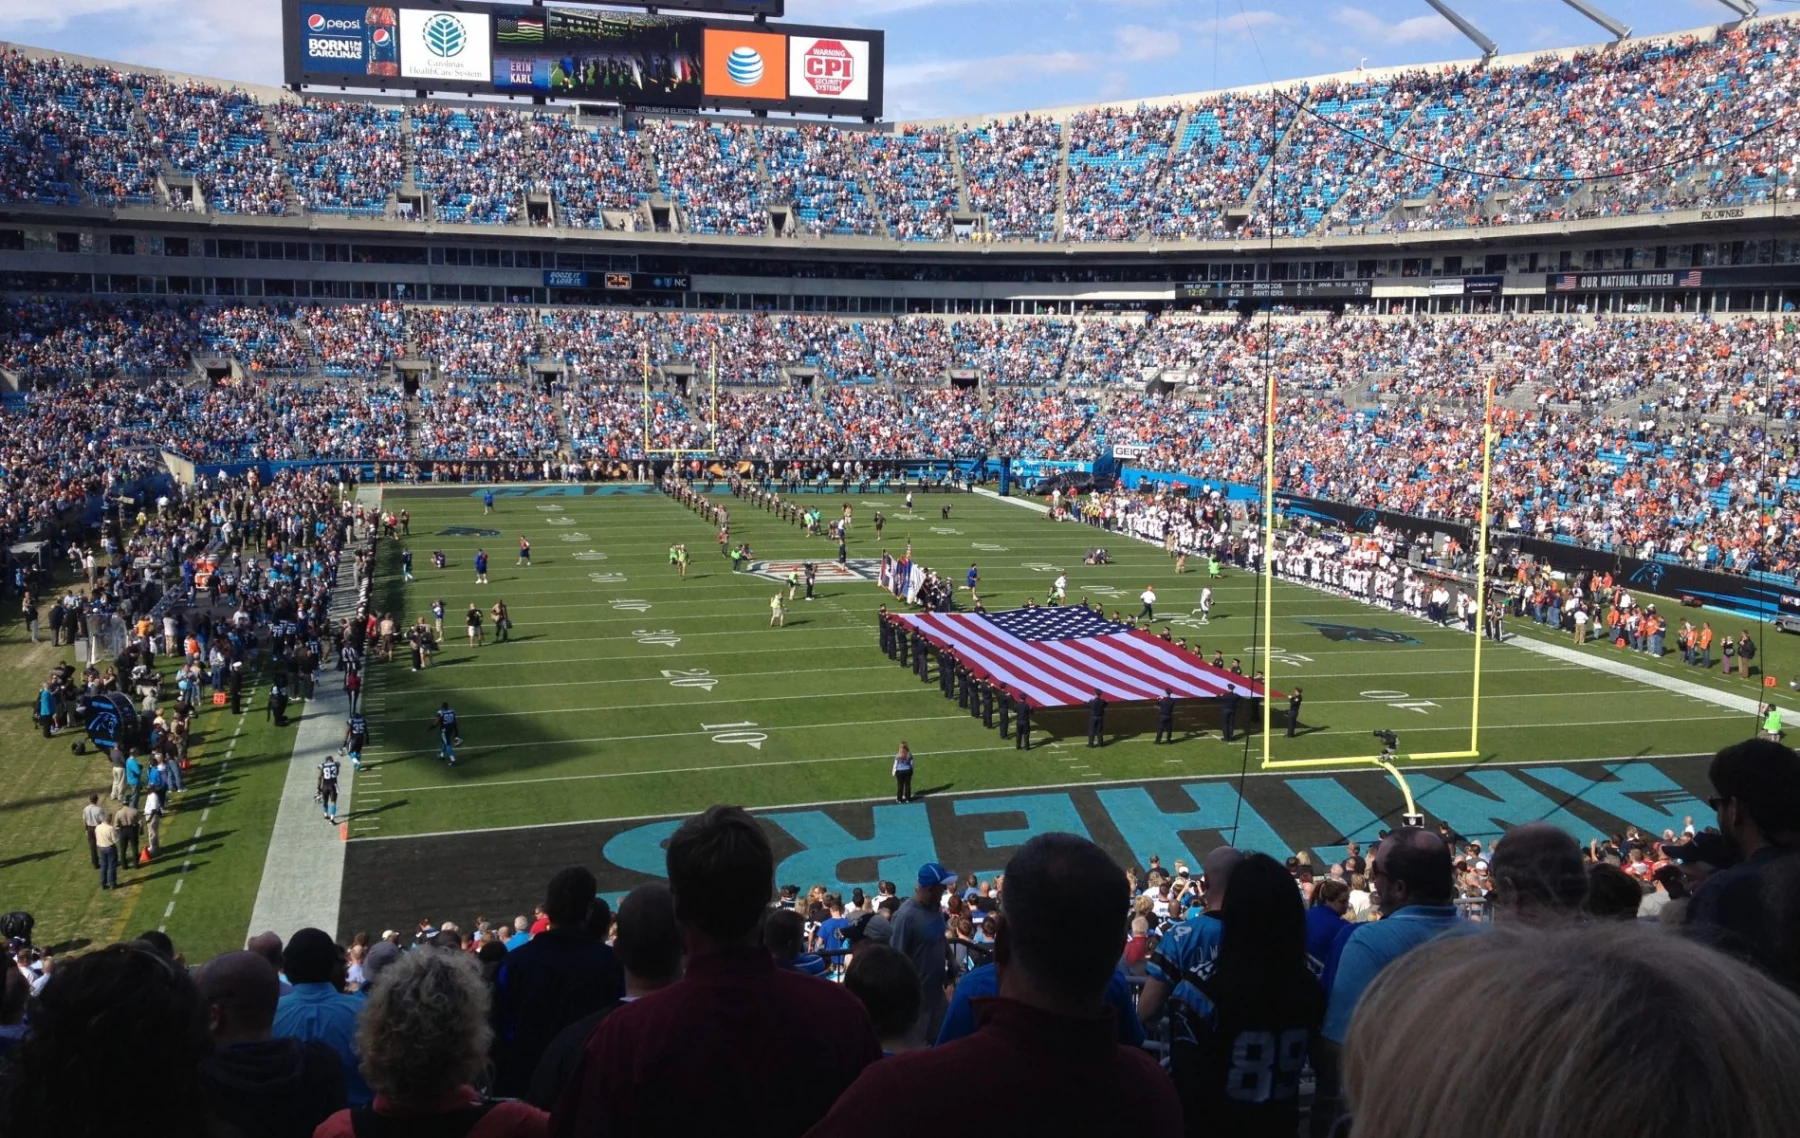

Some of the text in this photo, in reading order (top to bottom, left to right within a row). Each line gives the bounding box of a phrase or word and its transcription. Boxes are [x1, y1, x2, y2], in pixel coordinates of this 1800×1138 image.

[327, 19, 361, 30] pepsi
[308, 38, 350, 51] BORN
[308, 49, 362, 59] CAROLINAS
[812, 47, 846, 57] WARNING
[427, 59, 464, 68] Carolinas
[510, 61, 532, 72] ERIN
[807, 57, 851, 77] CPI
[409, 66, 483, 78] HealthCare System
[510, 73, 533, 84] KARL
[814, 78, 842, 86] SECURITY
[635, 105, 700, 115] MITSUBISHI ELECTRIC
[1701, 208, 1745, 220] PSL OWNERS
[550, 271, 572, 279] BOOZE
[1581, 273, 1674, 288] OUR NATIONAL ANTHEM
[674, 278, 687, 287] NC
[1187, 288, 1208, 297] 12:57
[631, 629, 681, 643] 30
[310, 644, 319, 654] 11
[660, 668, 719, 687] 20
[1359, 690, 1443, 710] 10
[352, 722, 365, 734] 35
[700, 721, 768, 743] 10
[323, 767, 337, 780] 83
